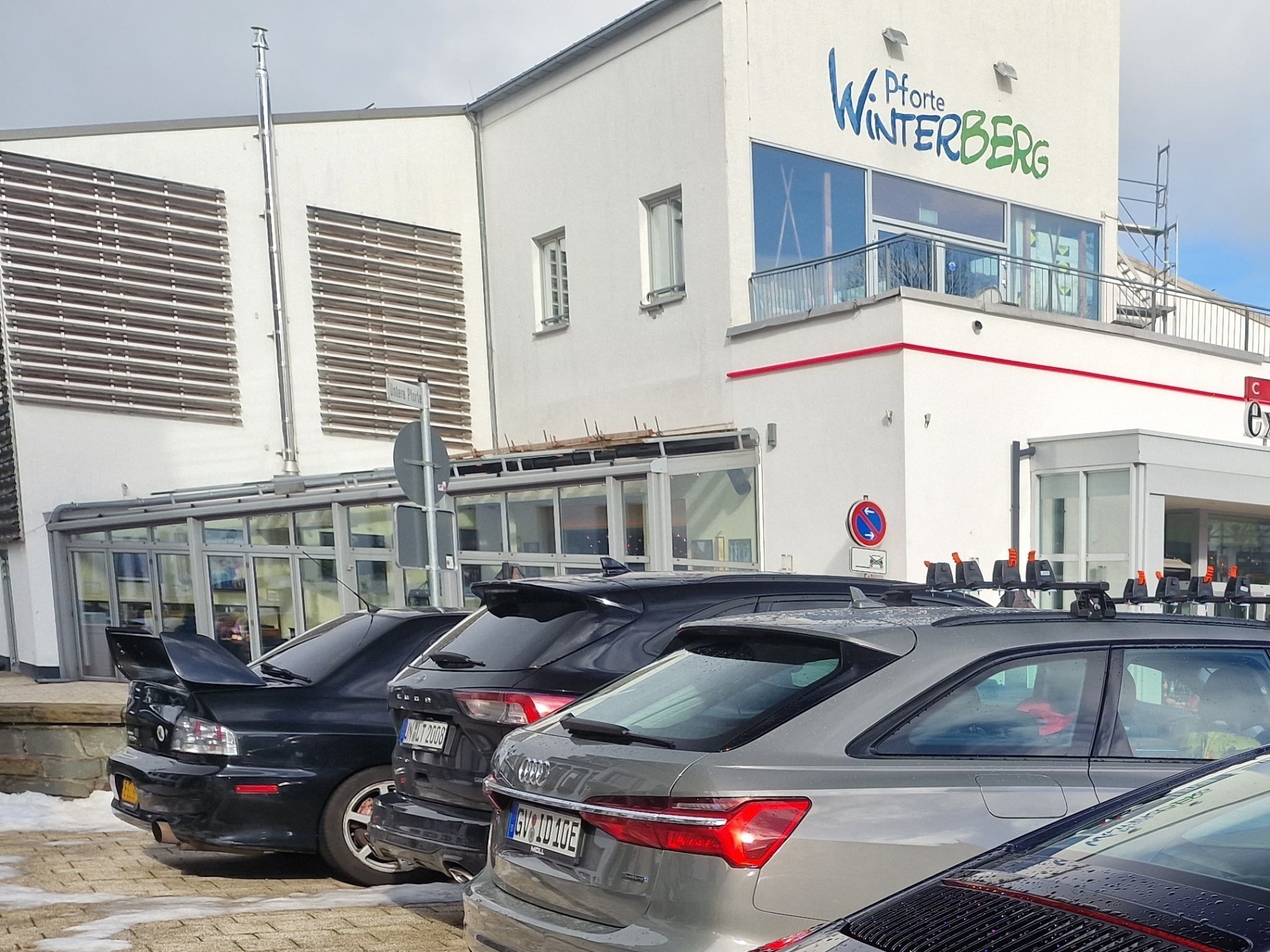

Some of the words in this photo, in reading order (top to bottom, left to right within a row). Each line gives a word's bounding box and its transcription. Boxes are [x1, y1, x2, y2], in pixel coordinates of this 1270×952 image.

[885, 69, 945, 111] Pforte
[425, 724, 446, 745] 2008
[515, 808, 532, 837] GV
